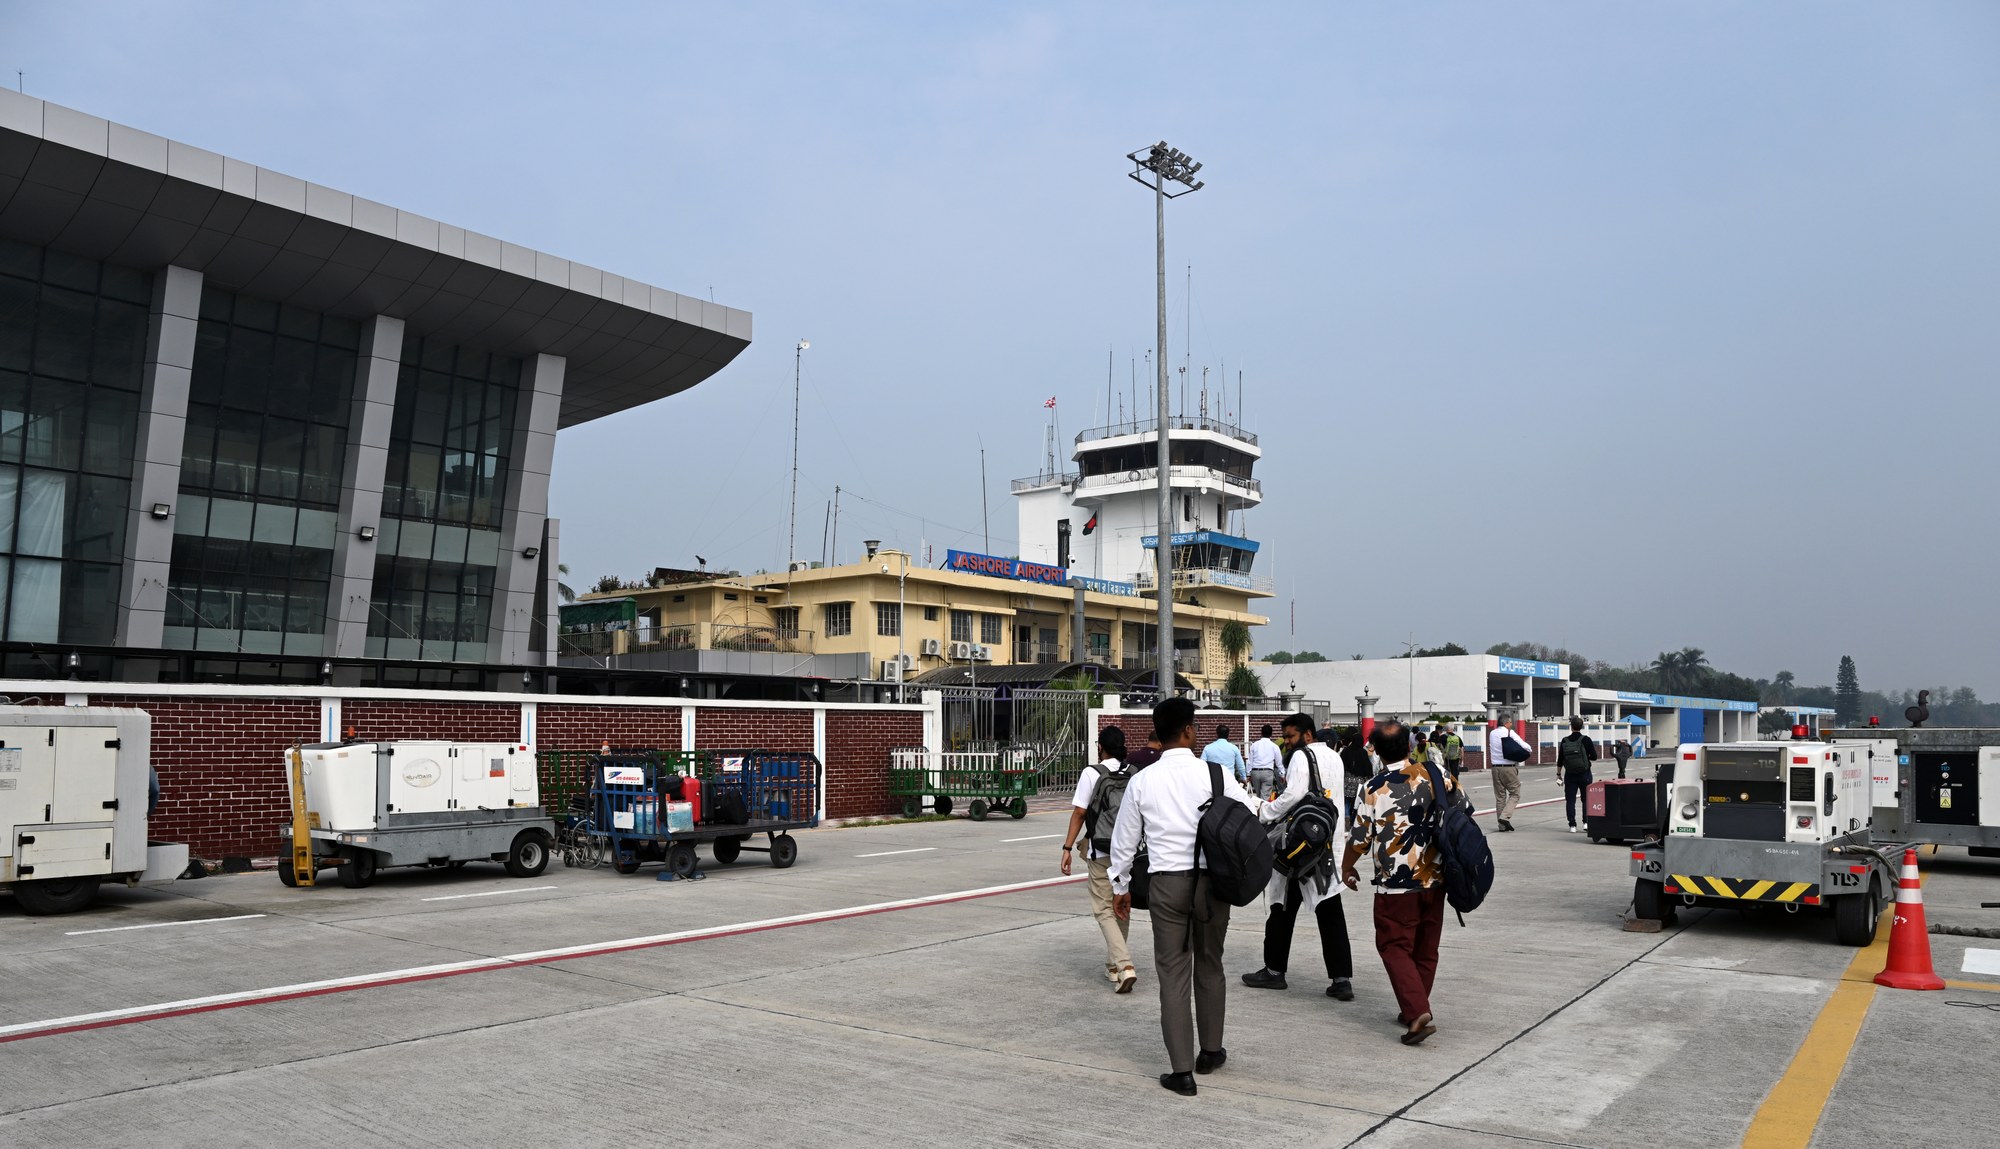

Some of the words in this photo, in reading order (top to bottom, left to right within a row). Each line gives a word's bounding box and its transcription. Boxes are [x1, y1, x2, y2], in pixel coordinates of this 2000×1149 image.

[1171, 534, 1194, 543] RESCUE
[1196, 533, 1209, 541] UNIT
[953, 553, 1011, 576] JASHORE
[1015, 563, 1064, 583] AIRPORT
[1542, 664, 1559, 677] NEST
[1758, 760, 1776, 769] TLD
[1637, 859, 1662, 873] TLD
[1830, 872, 1860, 887] TLD
